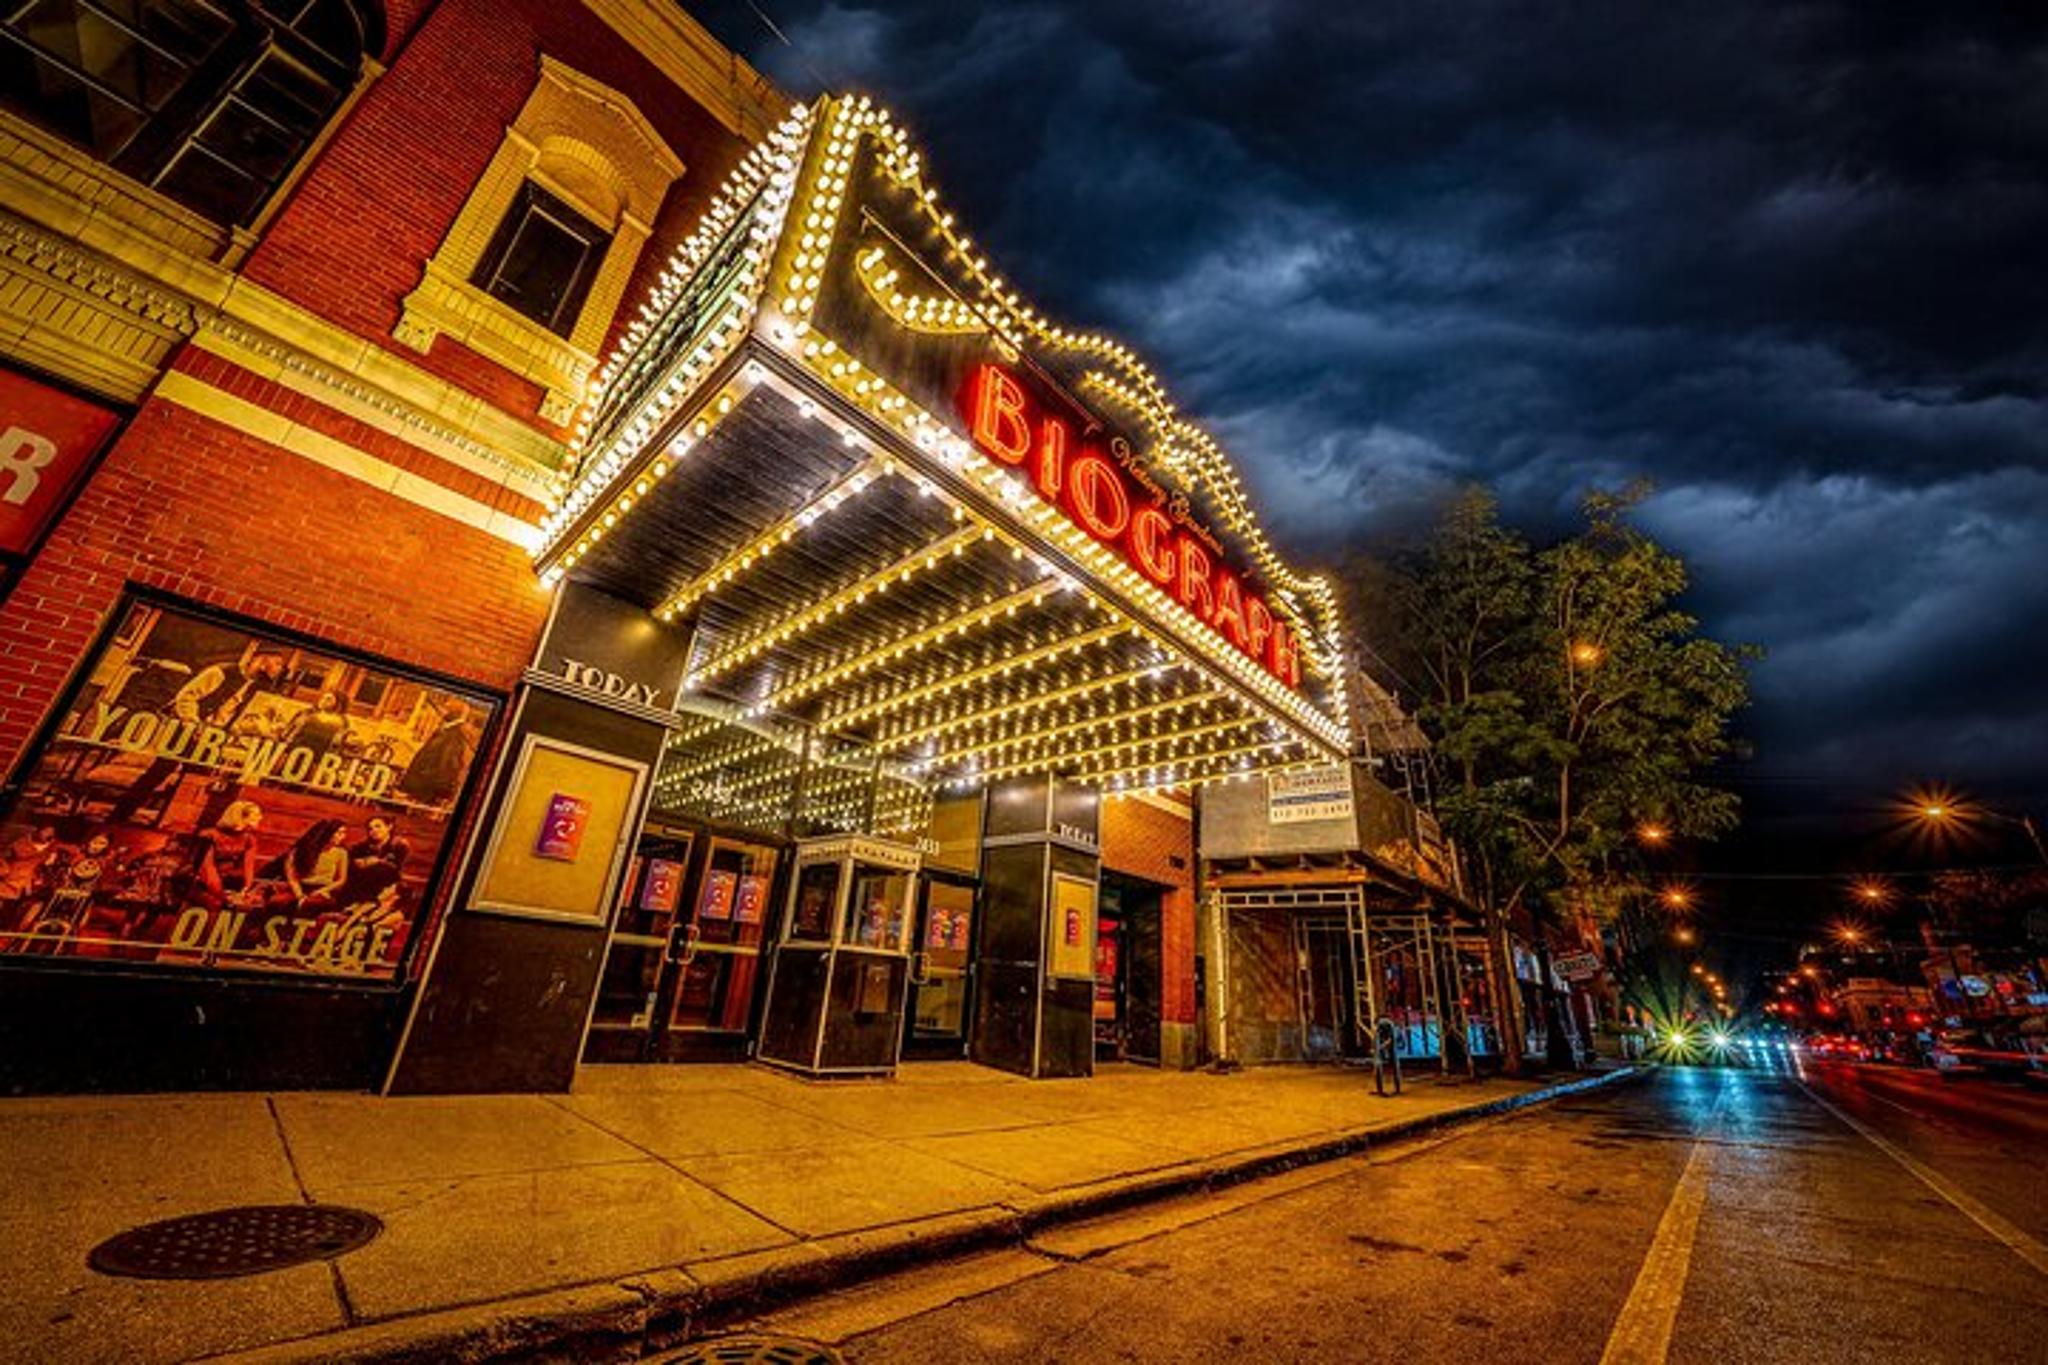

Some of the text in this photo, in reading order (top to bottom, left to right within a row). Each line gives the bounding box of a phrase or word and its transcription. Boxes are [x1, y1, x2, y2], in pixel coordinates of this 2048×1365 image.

[972, 363, 1300, 690] BIOGRAPH
[562, 657, 661, 707] TODAY
[91, 701, 393, 798] YOUR WORLD
[171, 906, 393, 967] ON STAGE
